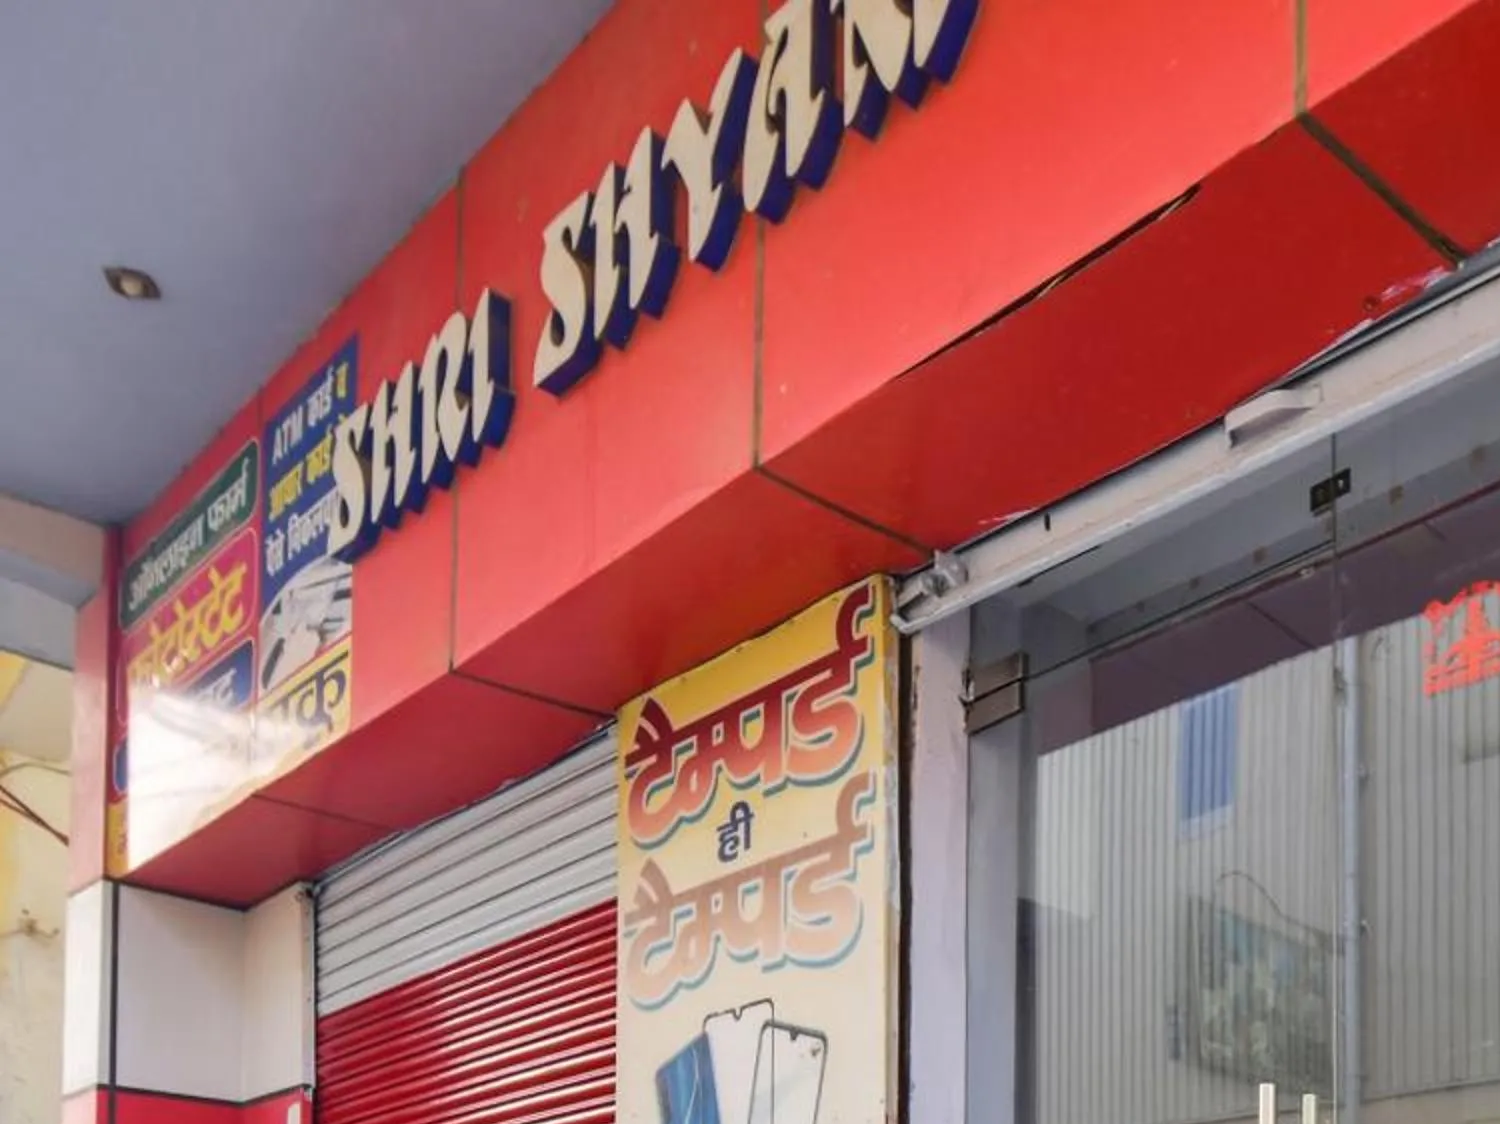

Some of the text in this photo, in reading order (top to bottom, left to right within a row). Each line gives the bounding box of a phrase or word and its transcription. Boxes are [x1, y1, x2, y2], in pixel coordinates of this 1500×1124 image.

[273, 404, 303, 464] ATM
[327, 287, 508, 560] SHRI
[717, 801, 754, 862] ही
